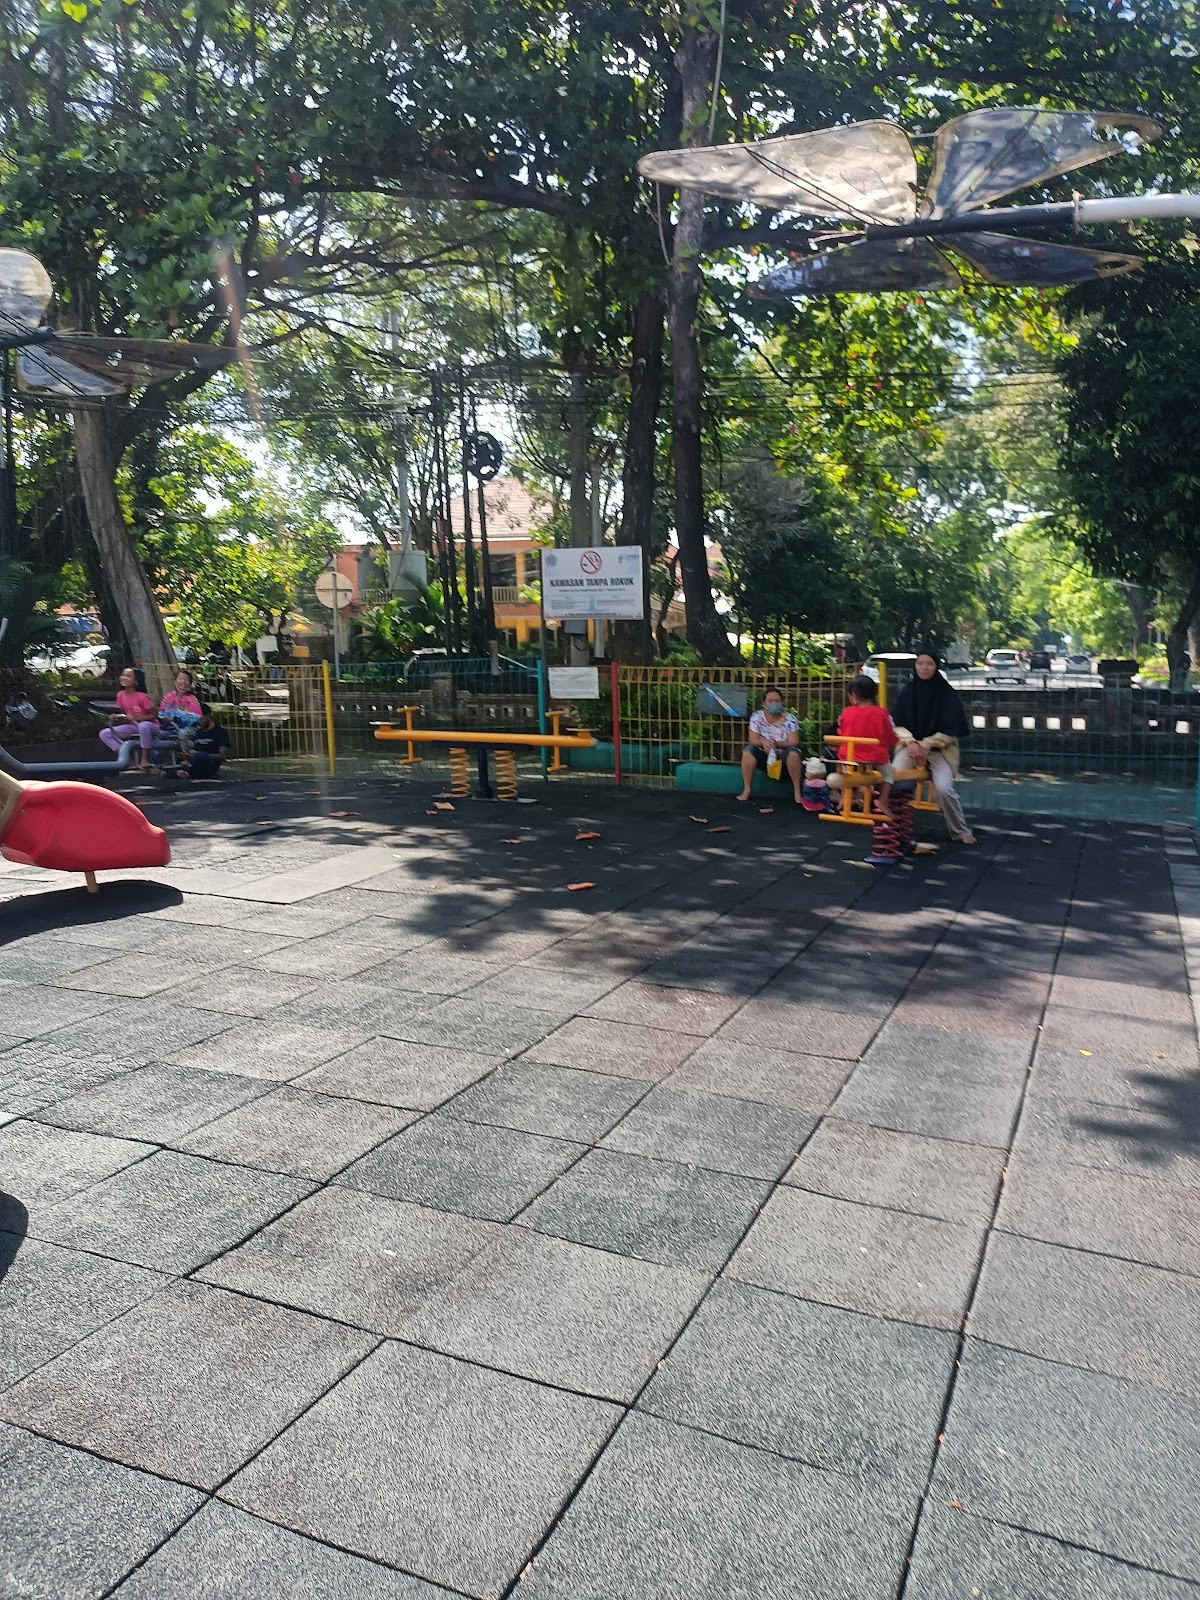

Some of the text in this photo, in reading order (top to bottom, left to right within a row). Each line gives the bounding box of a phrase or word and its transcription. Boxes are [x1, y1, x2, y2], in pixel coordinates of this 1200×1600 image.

[549, 577, 634, 587] KAWASAN TANPA ROKOK
